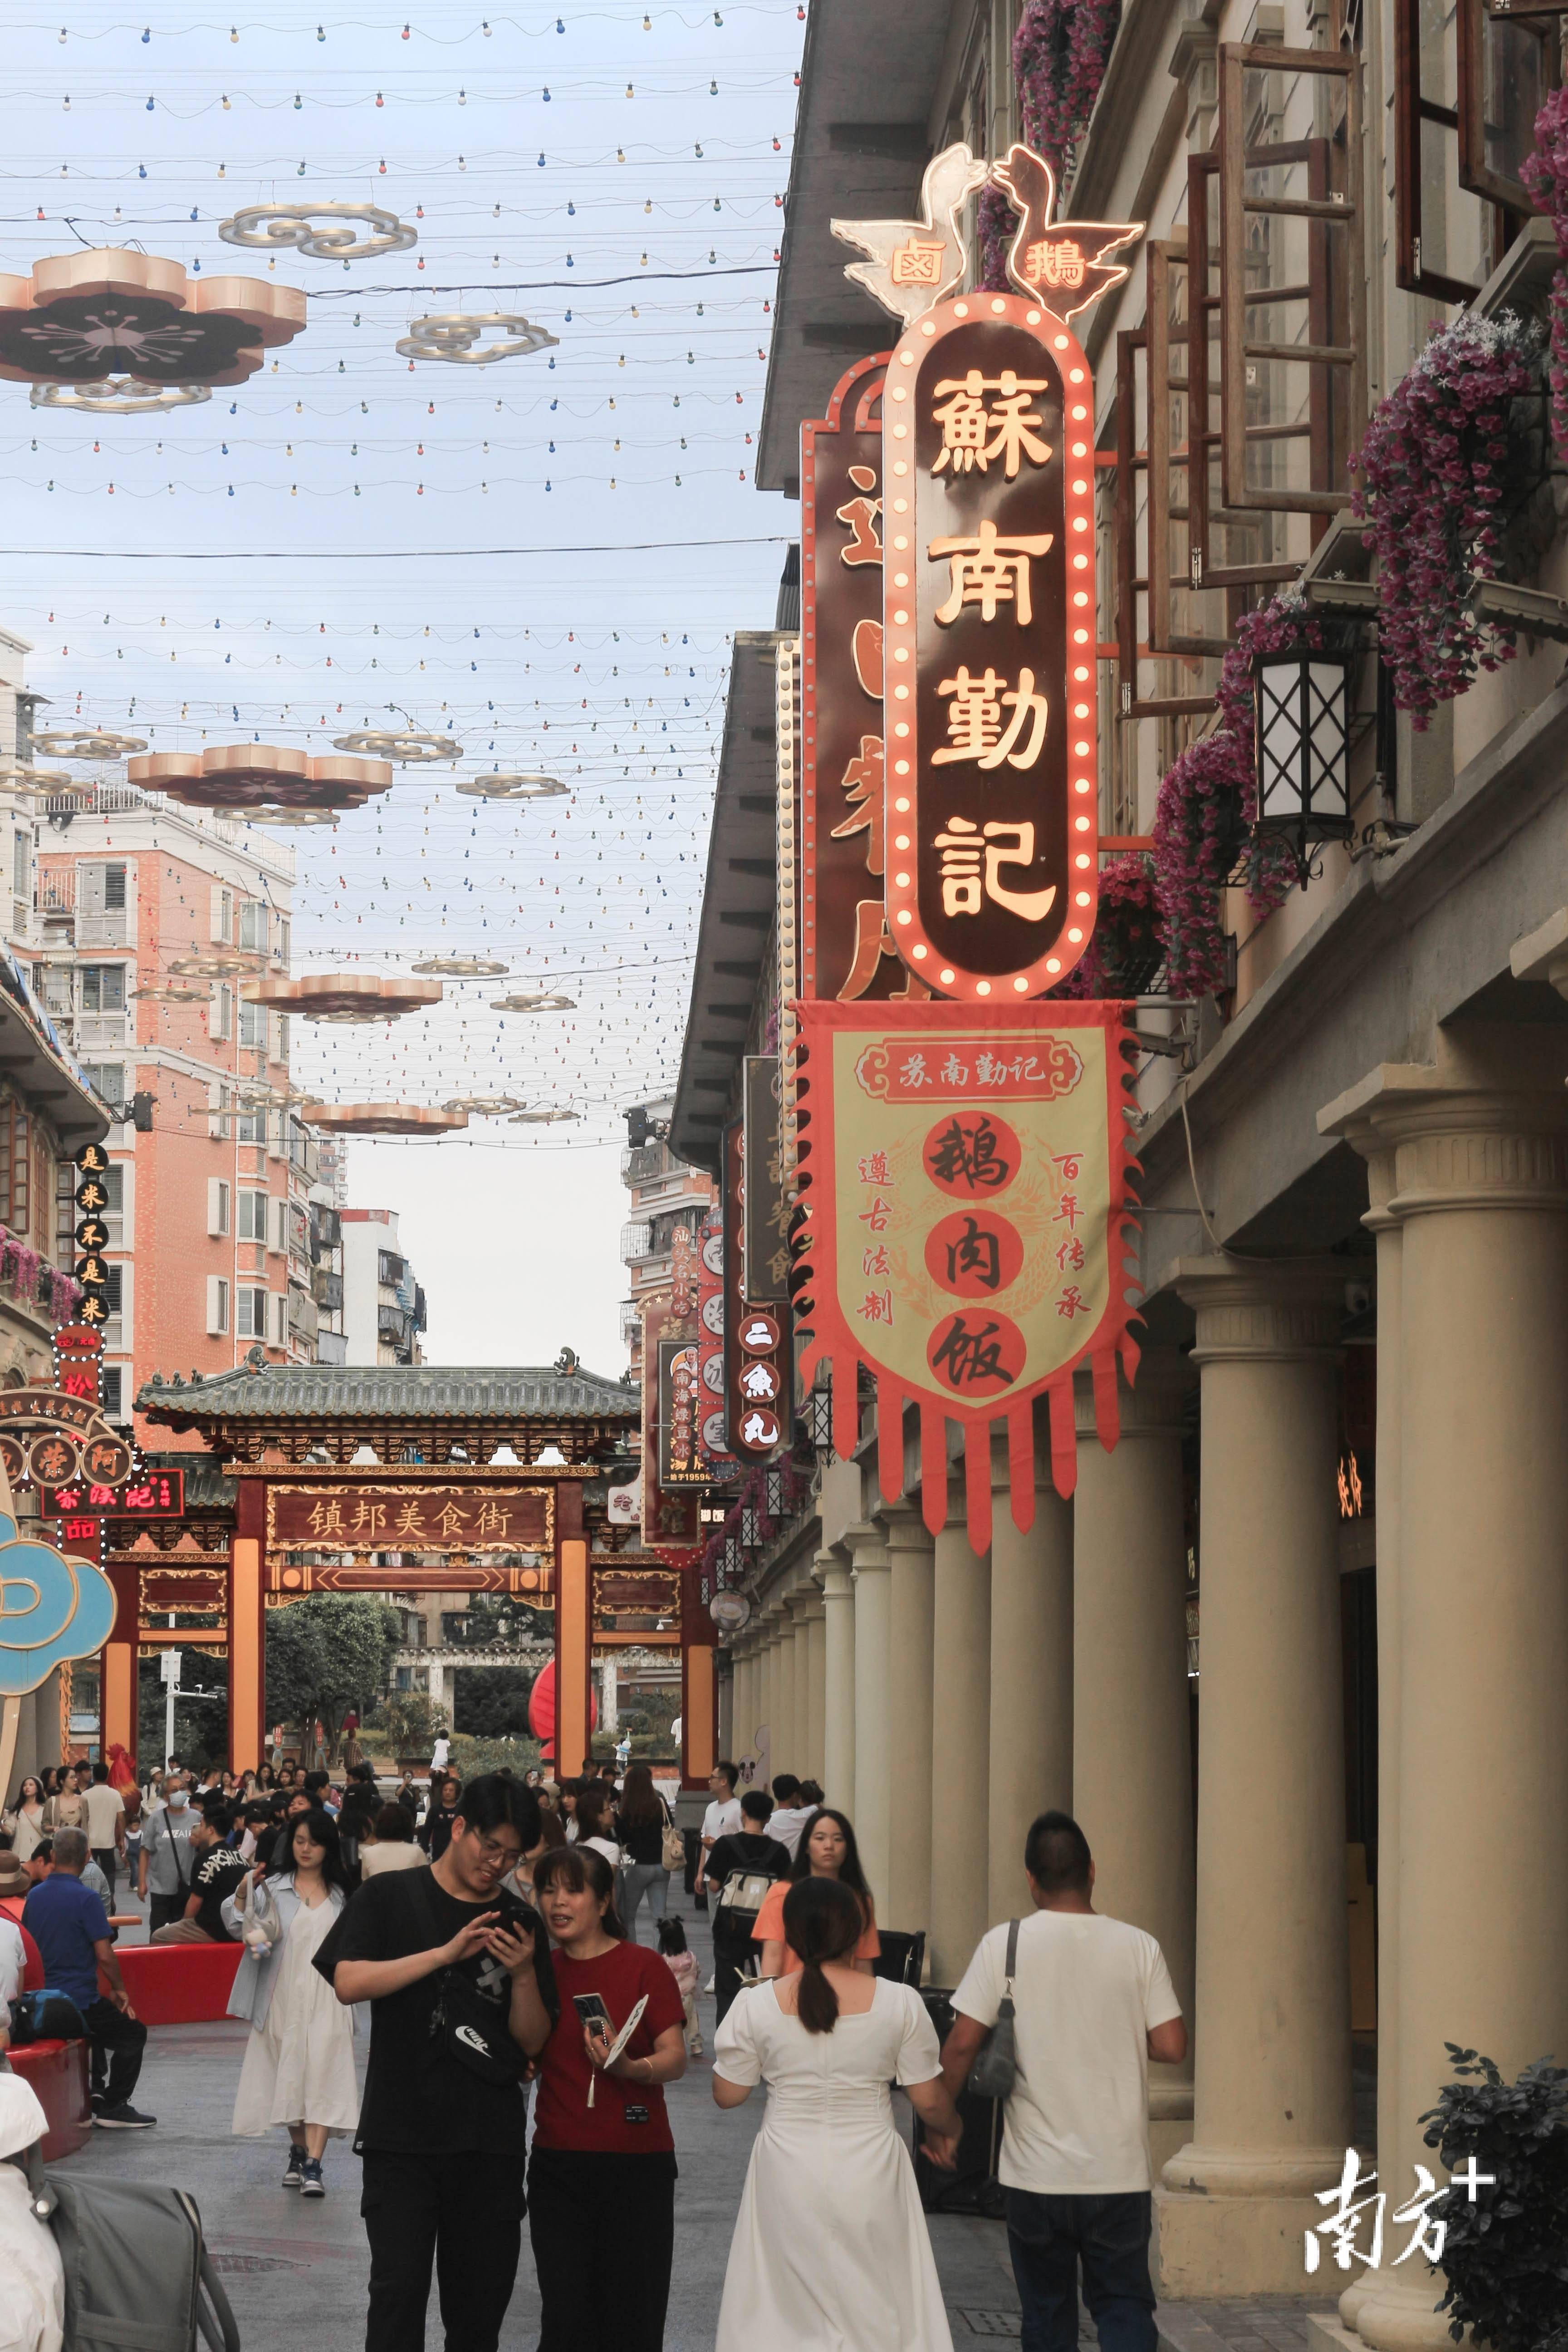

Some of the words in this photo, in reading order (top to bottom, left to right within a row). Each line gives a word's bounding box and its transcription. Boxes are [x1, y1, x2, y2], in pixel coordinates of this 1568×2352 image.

[928, 369, 1057, 923] 蘇南勤記
[900, 1052, 1046, 1088] 苏南勤记
[80, 1146, 105, 1323] 是米不是米
[674, 1230, 689, 1315] 汕头名小吃
[856, 1152, 895, 1327] 遵古法制
[1051, 1152, 1093, 1320] 百年传承
[674, 1373, 691, 1458] 南海绿豆冰
[307, 1499, 513, 1538] 镇邦美食街
